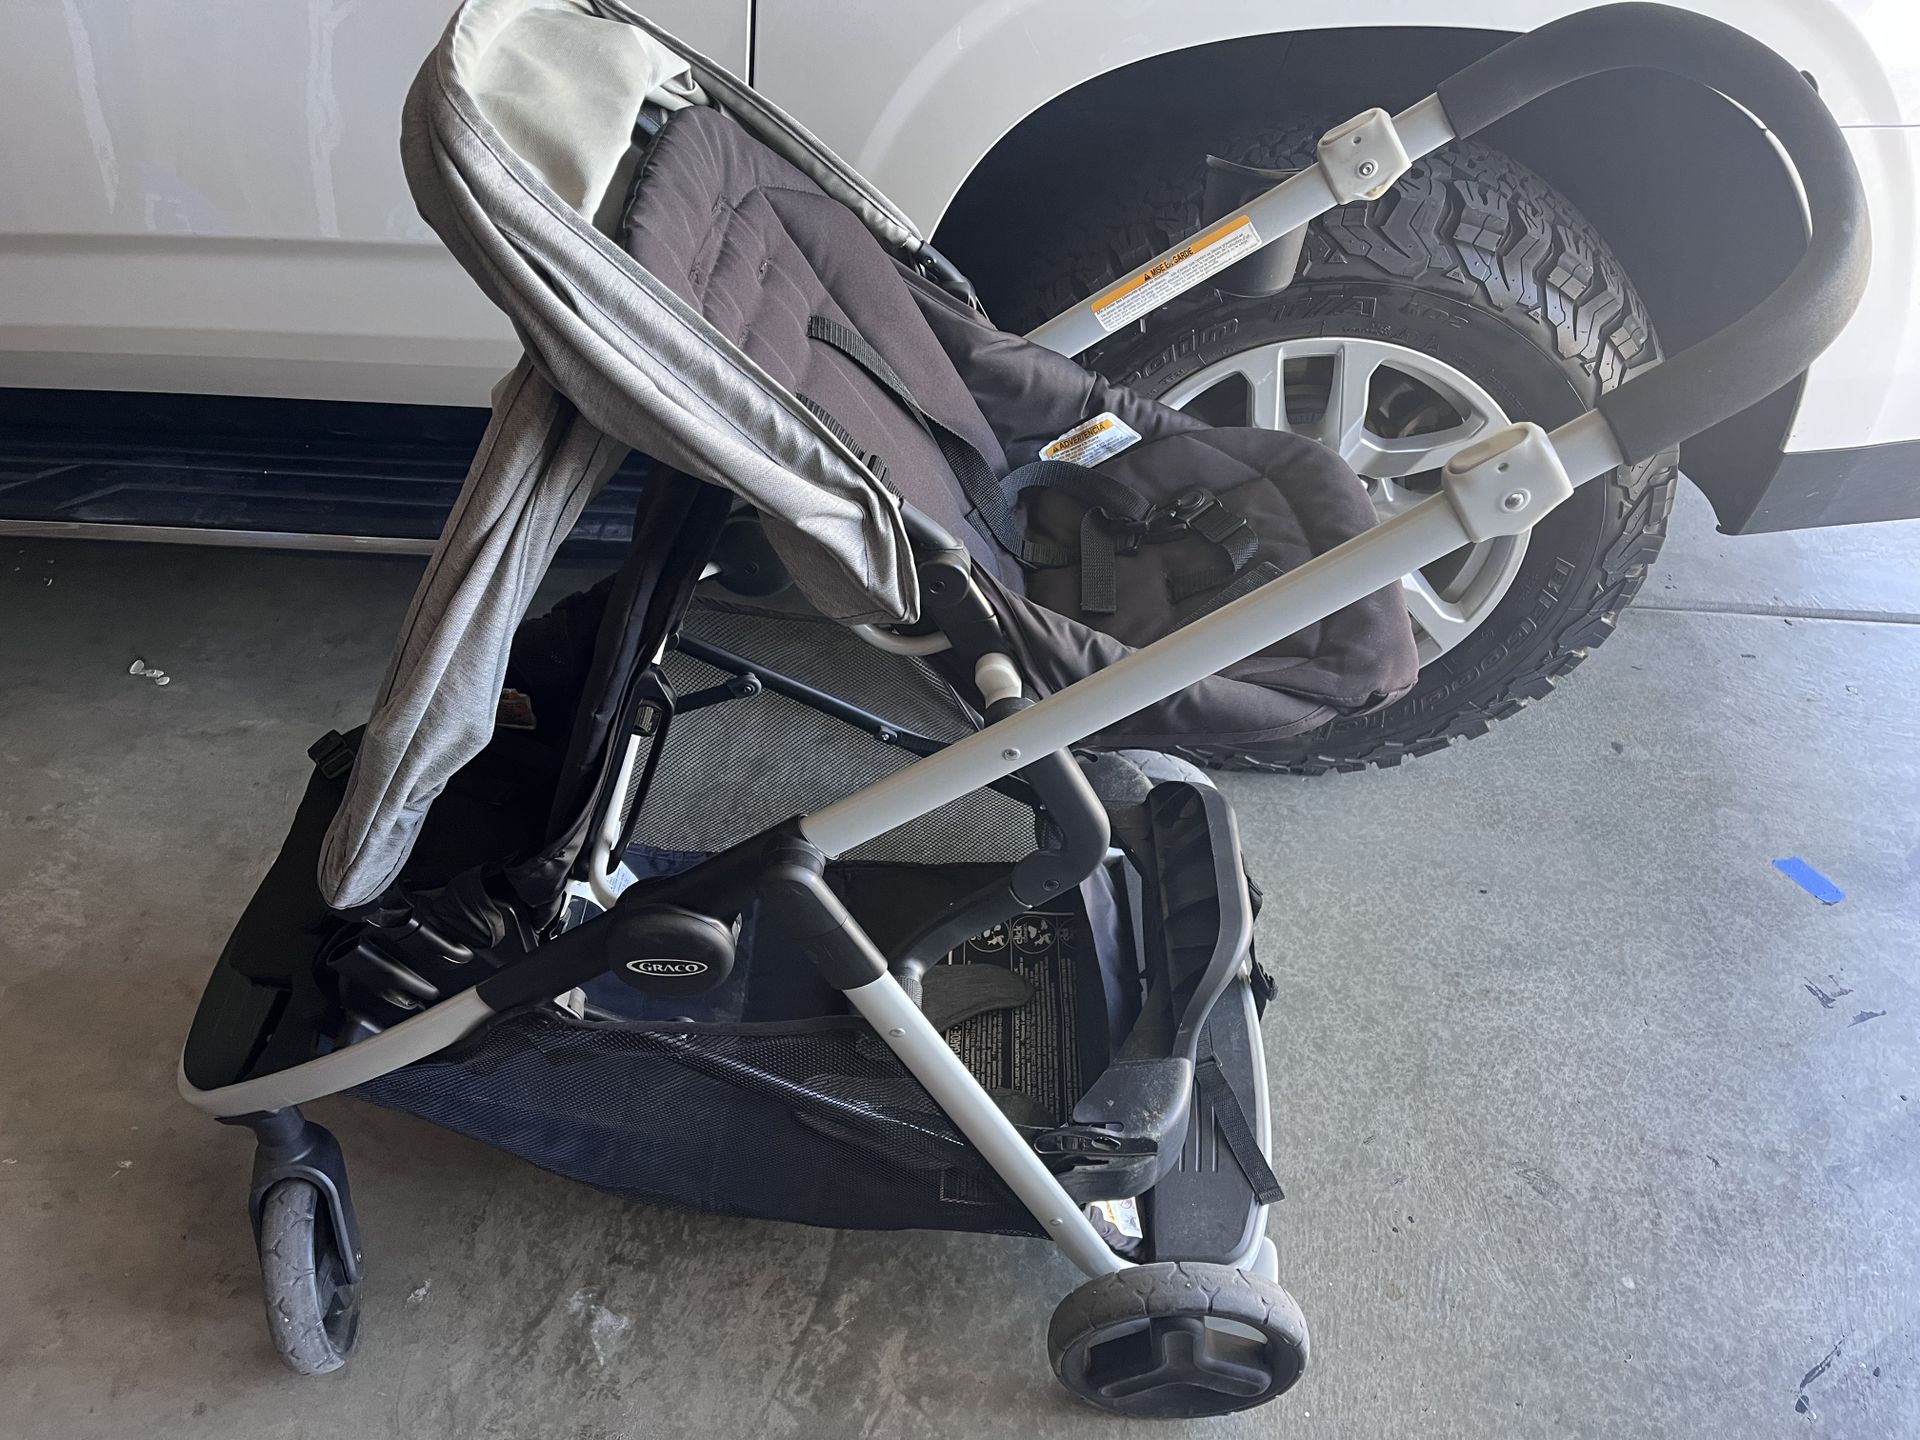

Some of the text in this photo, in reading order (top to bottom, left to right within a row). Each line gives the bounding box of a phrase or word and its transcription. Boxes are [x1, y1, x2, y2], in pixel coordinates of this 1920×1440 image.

[1151, 264, 1166, 276] MISE
[1172, 247, 1194, 265] GARDE
[1059, 422, 1105, 449] ADVERTENCIA
[638, 962, 699, 972] GRACO
